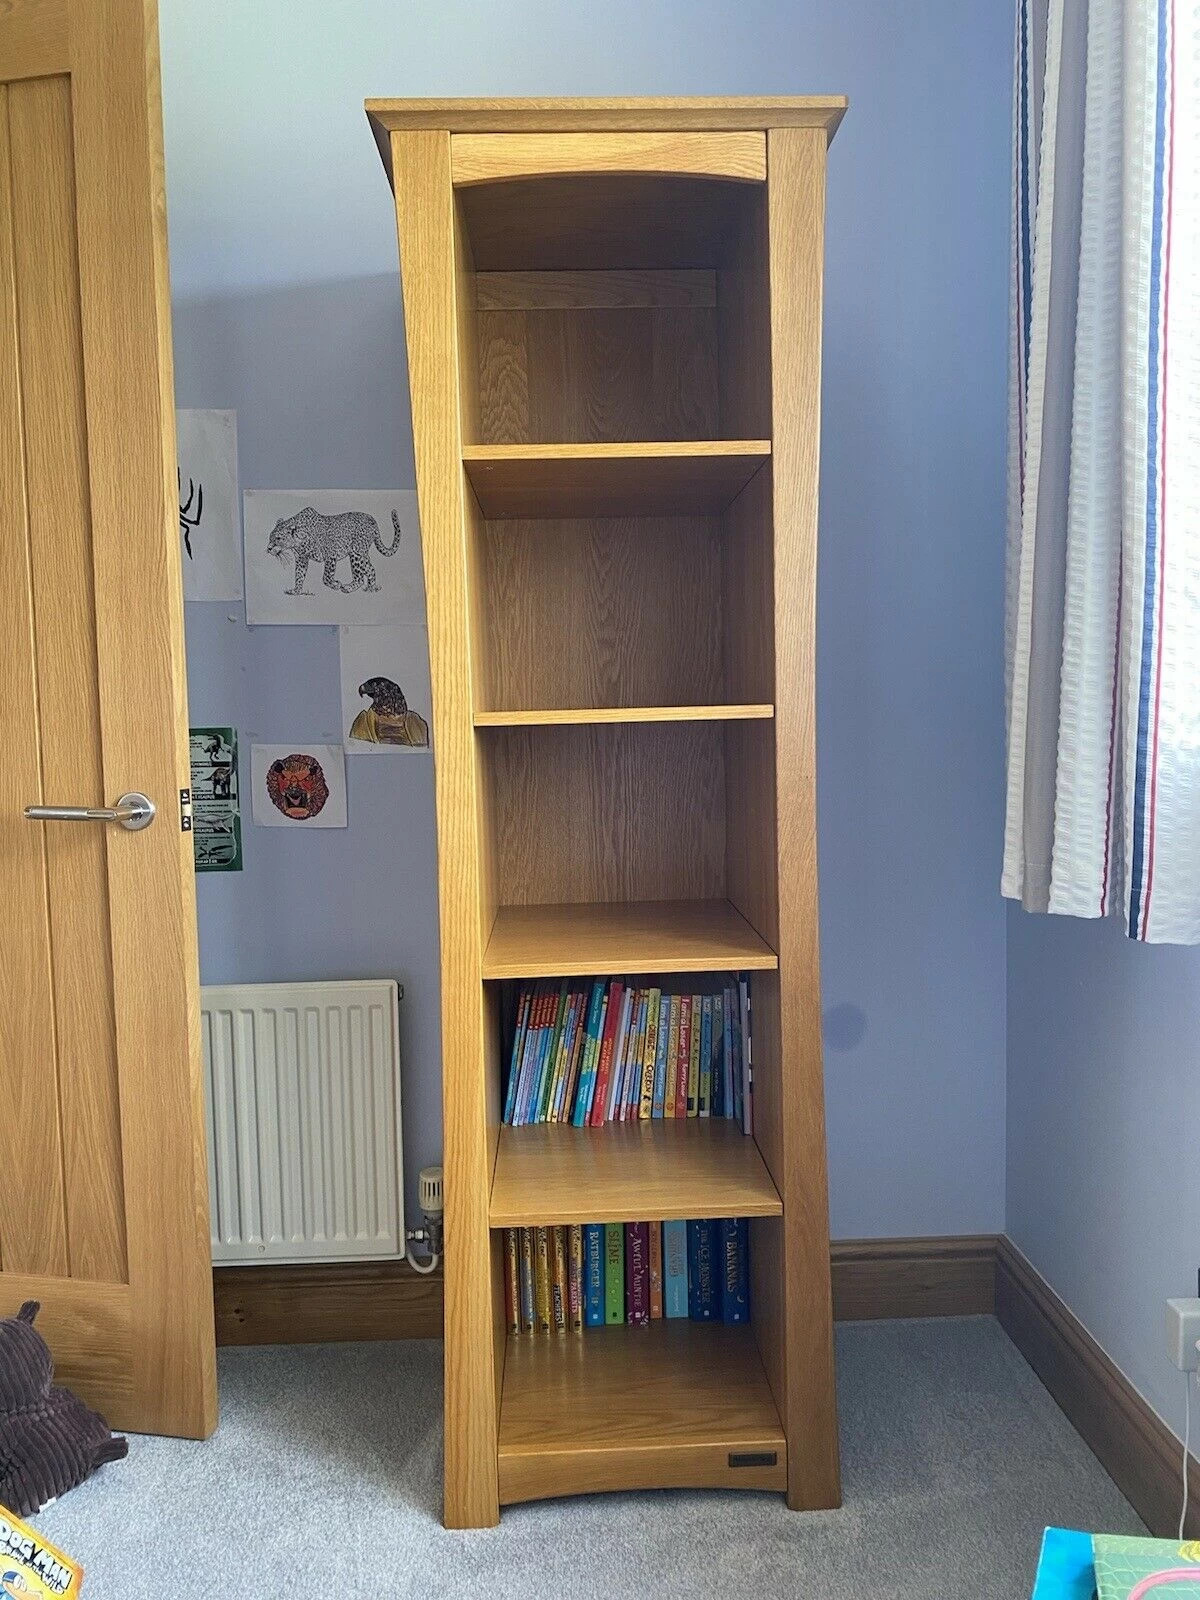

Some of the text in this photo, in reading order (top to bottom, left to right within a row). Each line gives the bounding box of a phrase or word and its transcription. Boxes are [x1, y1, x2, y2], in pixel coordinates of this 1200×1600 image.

[660, 1004, 666, 1019] am
[670, 1003, 677, 1018] am
[681, 1002, 688, 1017] am
[659, 1026, 667, 1048] Loser
[669, 1026, 678, 1050] Loser
[680, 1025, 689, 1049] Loser
[588, 1231, 600, 1288] RATBURGER
[607, 1230, 620, 1265] SLIME
[725, 1240, 738, 1293] BANANAS
[699, 1262, 711, 1304] MONSTER
[552, 1286, 561, 1321] TEACHERS
[0, 1519, 35, 1559] DOG
[34, 1549, 72, 1589] MAN
